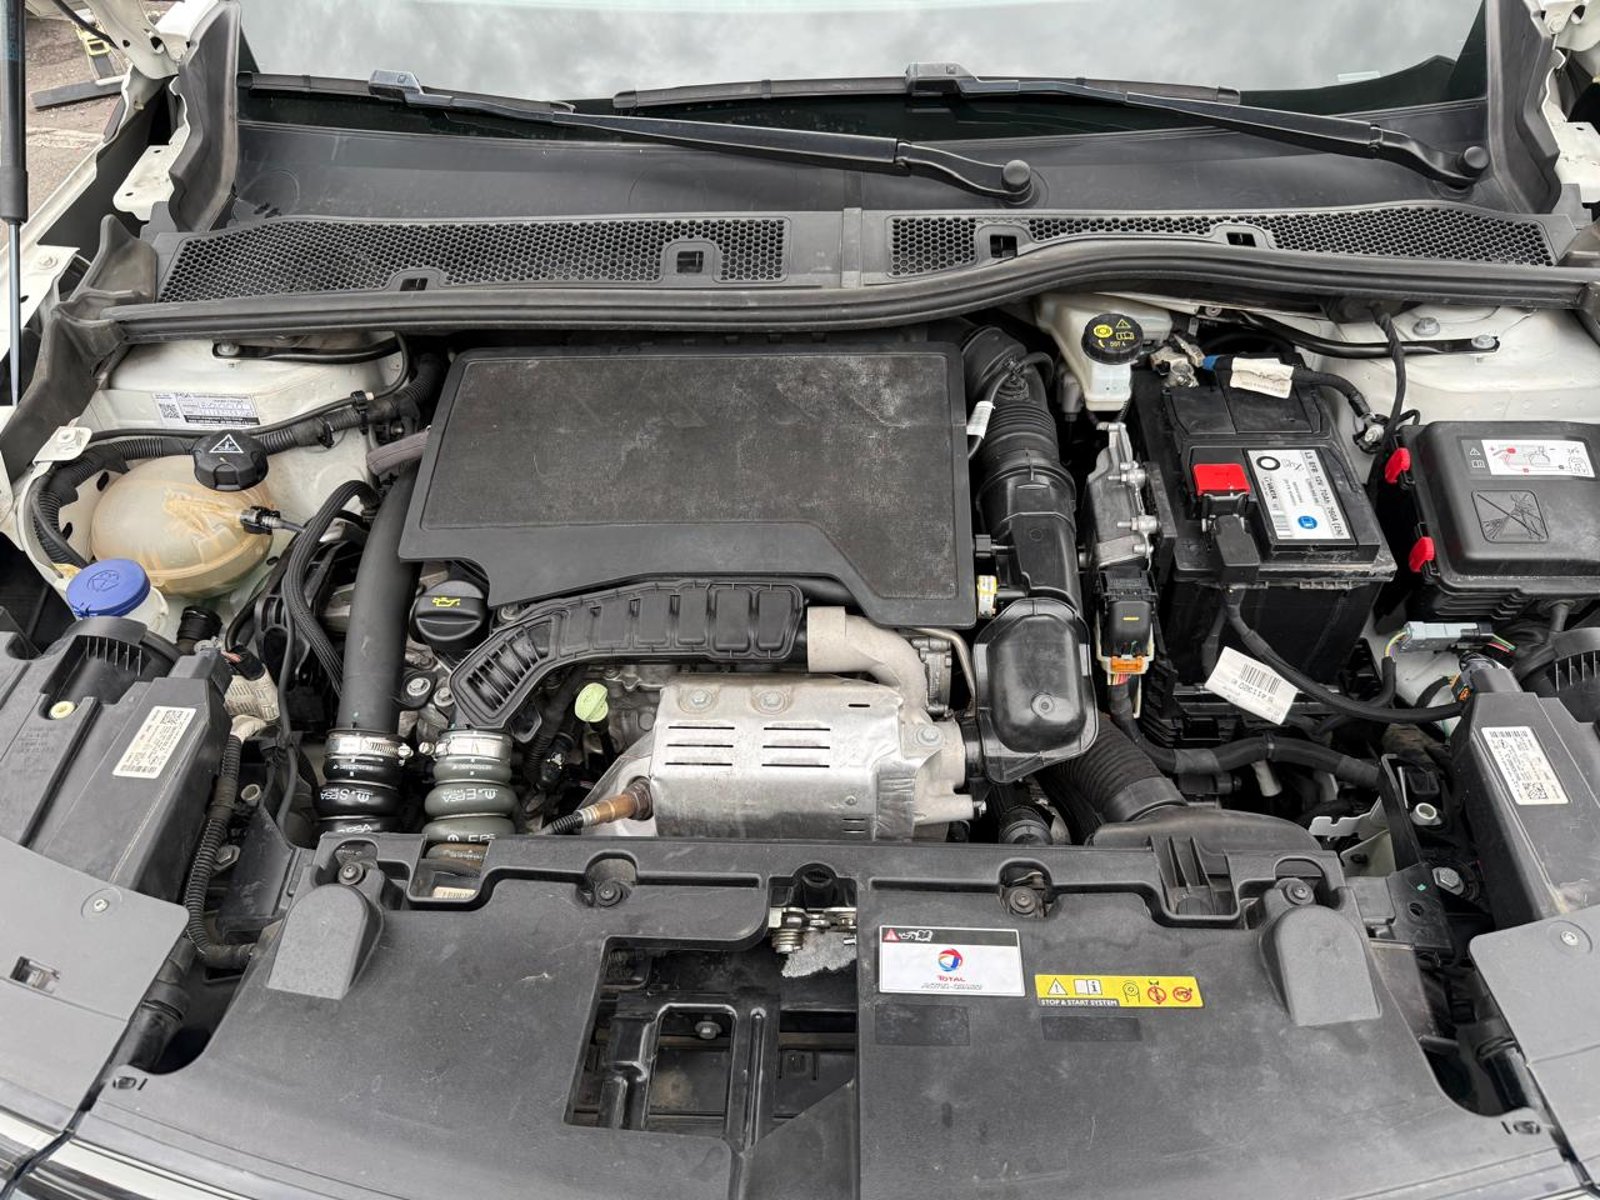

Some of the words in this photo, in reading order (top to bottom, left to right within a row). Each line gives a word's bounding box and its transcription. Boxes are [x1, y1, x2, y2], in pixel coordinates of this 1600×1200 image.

[1308, 461, 1318, 473] EFB
[1314, 475, 1322, 486] 12V
[1320, 489, 1331, 505] 70Ah
